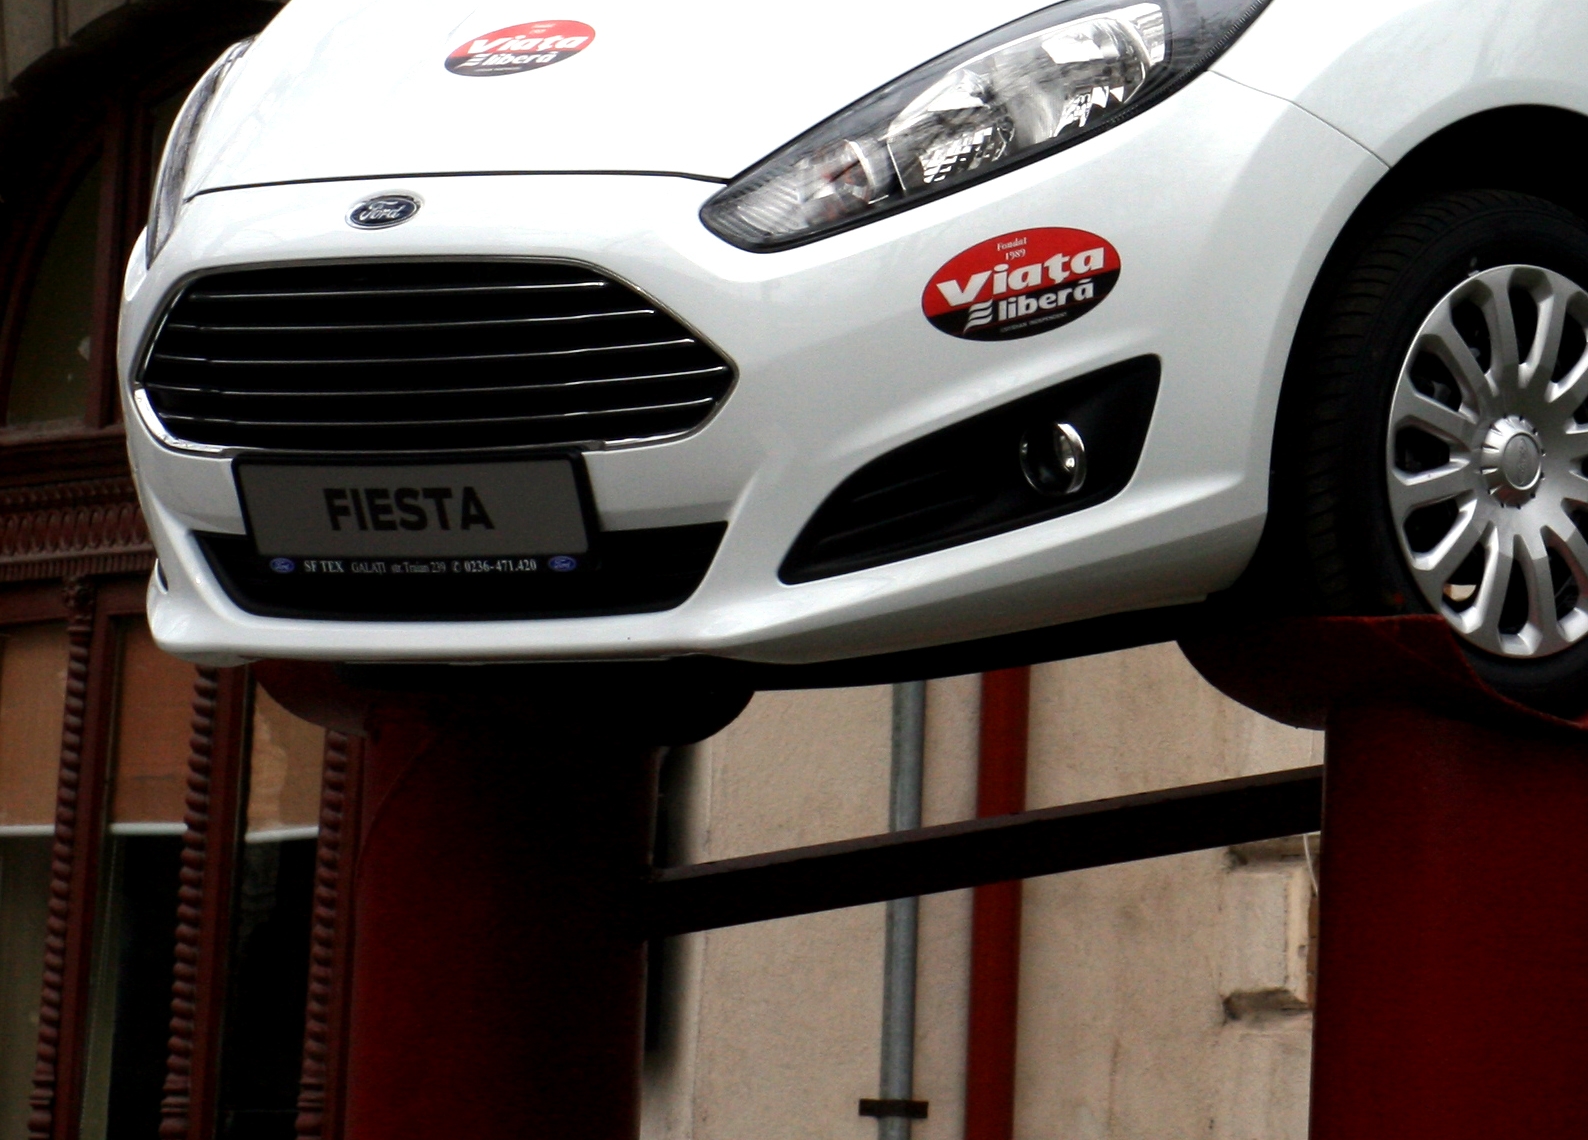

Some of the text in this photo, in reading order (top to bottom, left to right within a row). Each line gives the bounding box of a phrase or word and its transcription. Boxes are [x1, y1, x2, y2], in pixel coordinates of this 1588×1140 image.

[359, 200, 404, 222] Ford
[996, 236, 1028, 251] Fondat
[1004, 248, 1026, 261] 1989
[322, 486, 495, 531] FIESTA
[304, 561, 320, 572] SF
[322, 561, 344, 572] TEX
[464, 560, 537, 573] 0236-471.420
